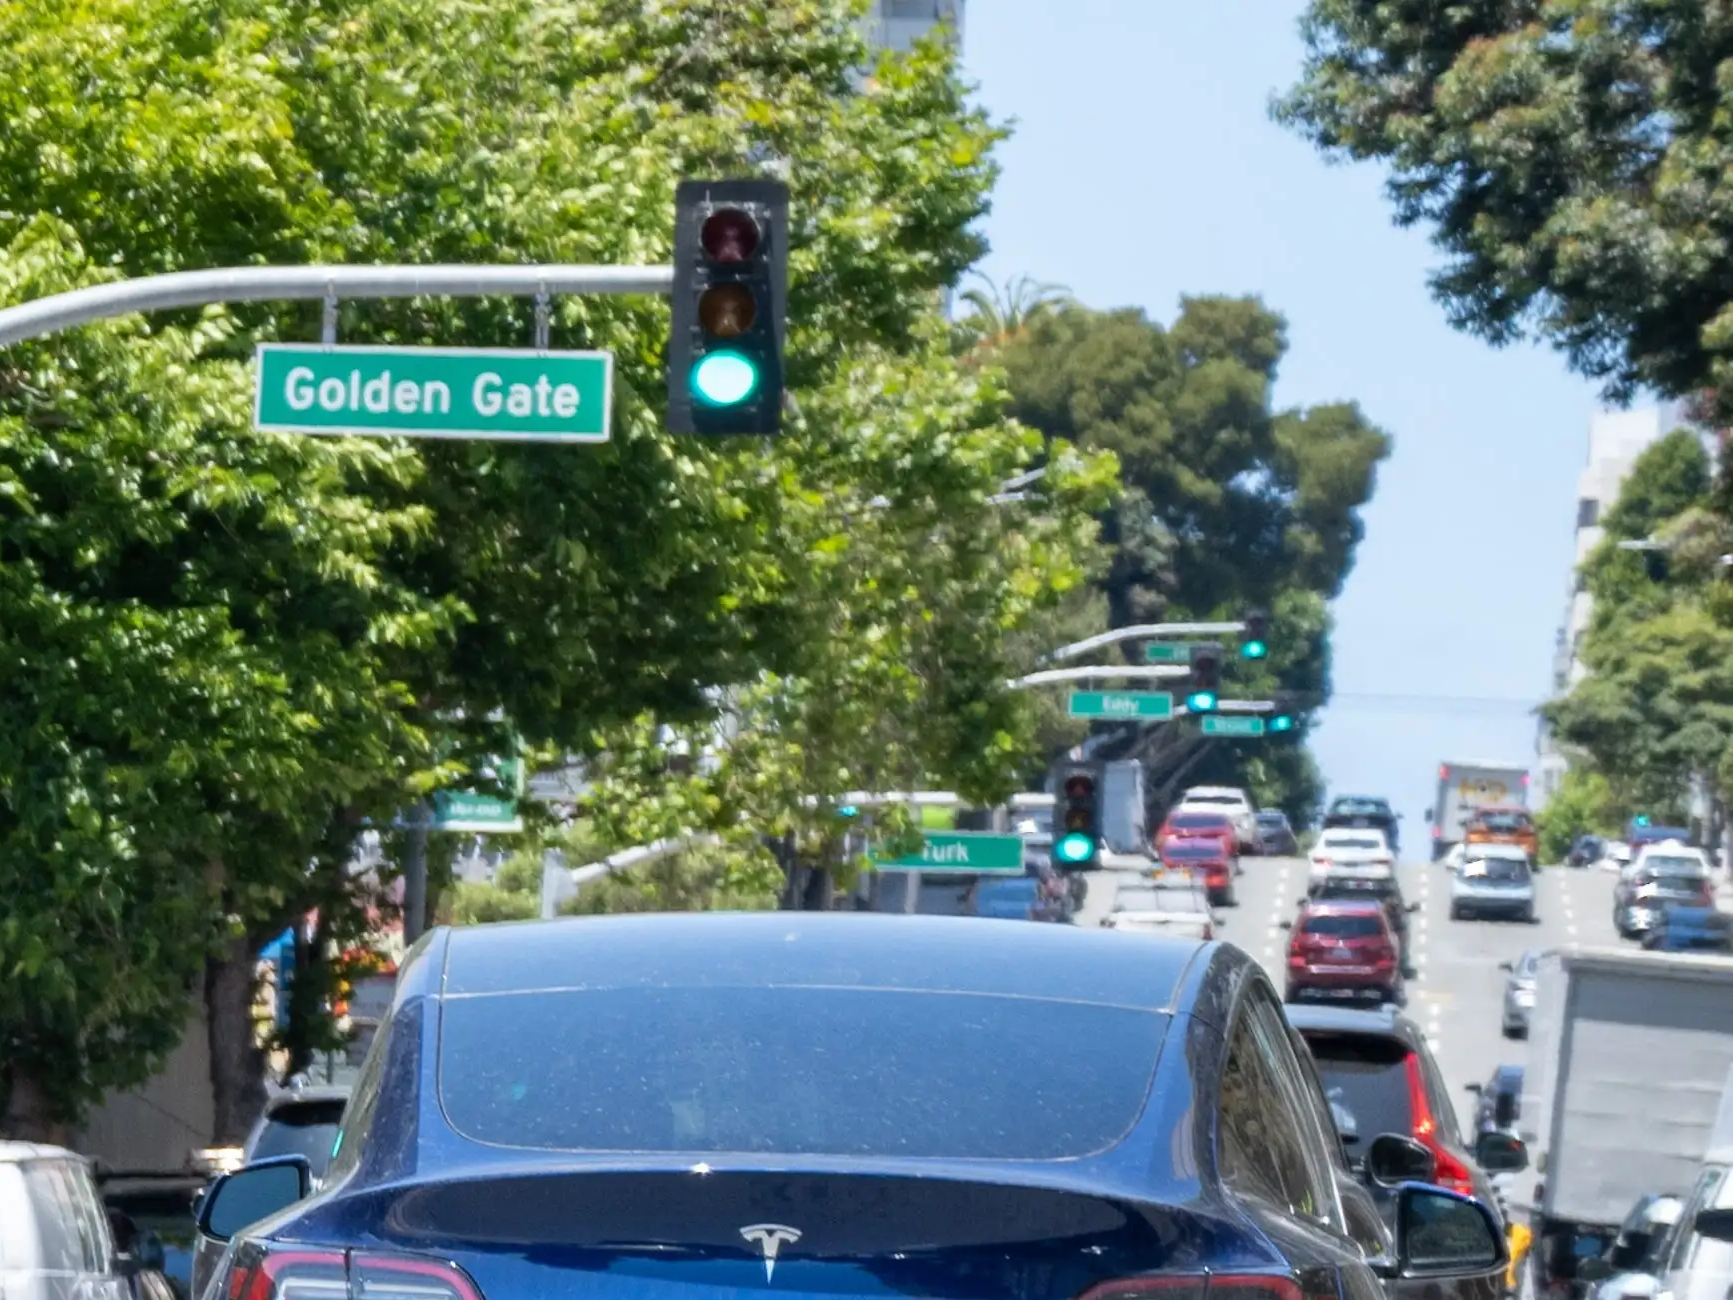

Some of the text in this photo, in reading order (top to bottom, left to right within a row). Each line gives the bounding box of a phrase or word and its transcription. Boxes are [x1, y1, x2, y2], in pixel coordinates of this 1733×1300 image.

[285, 367, 580, 417] Golden Gate
[922, 840, 969, 863] Turk
